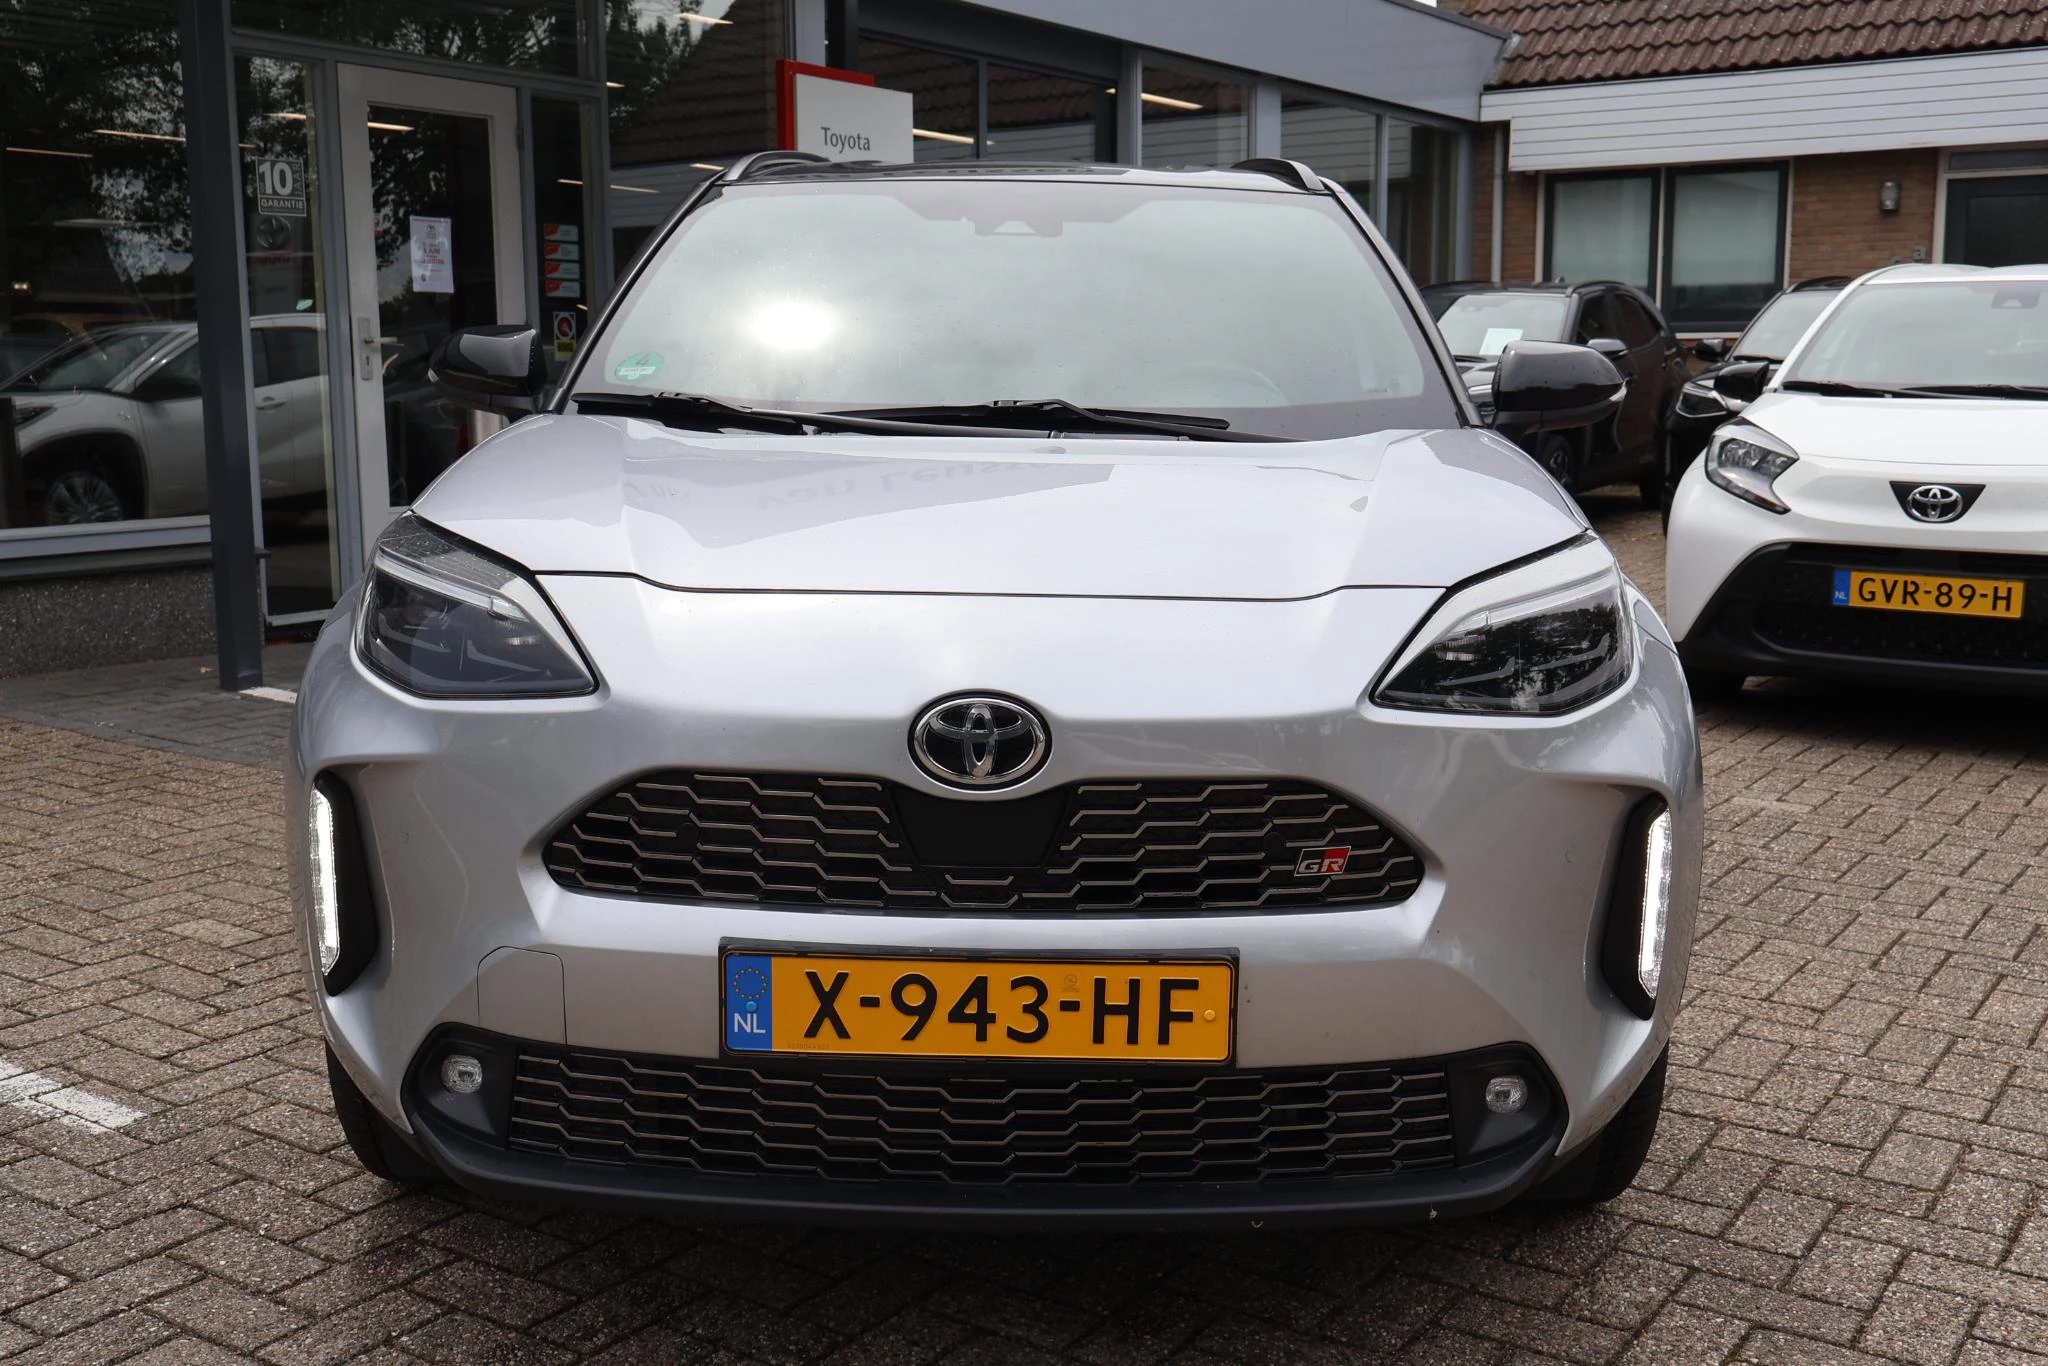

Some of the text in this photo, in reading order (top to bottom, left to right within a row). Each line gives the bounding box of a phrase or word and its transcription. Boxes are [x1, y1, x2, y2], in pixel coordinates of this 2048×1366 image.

[821, 126, 871, 154] Toyota
[260, 161, 292, 196] 10
[261, 198, 304, 210] GARANTIE
[1835, 577, 2013, 612] NL GVR-89-H
[1298, 858, 1345, 873] GR
[733, 970, 1199, 1045] NL X-943-HF
